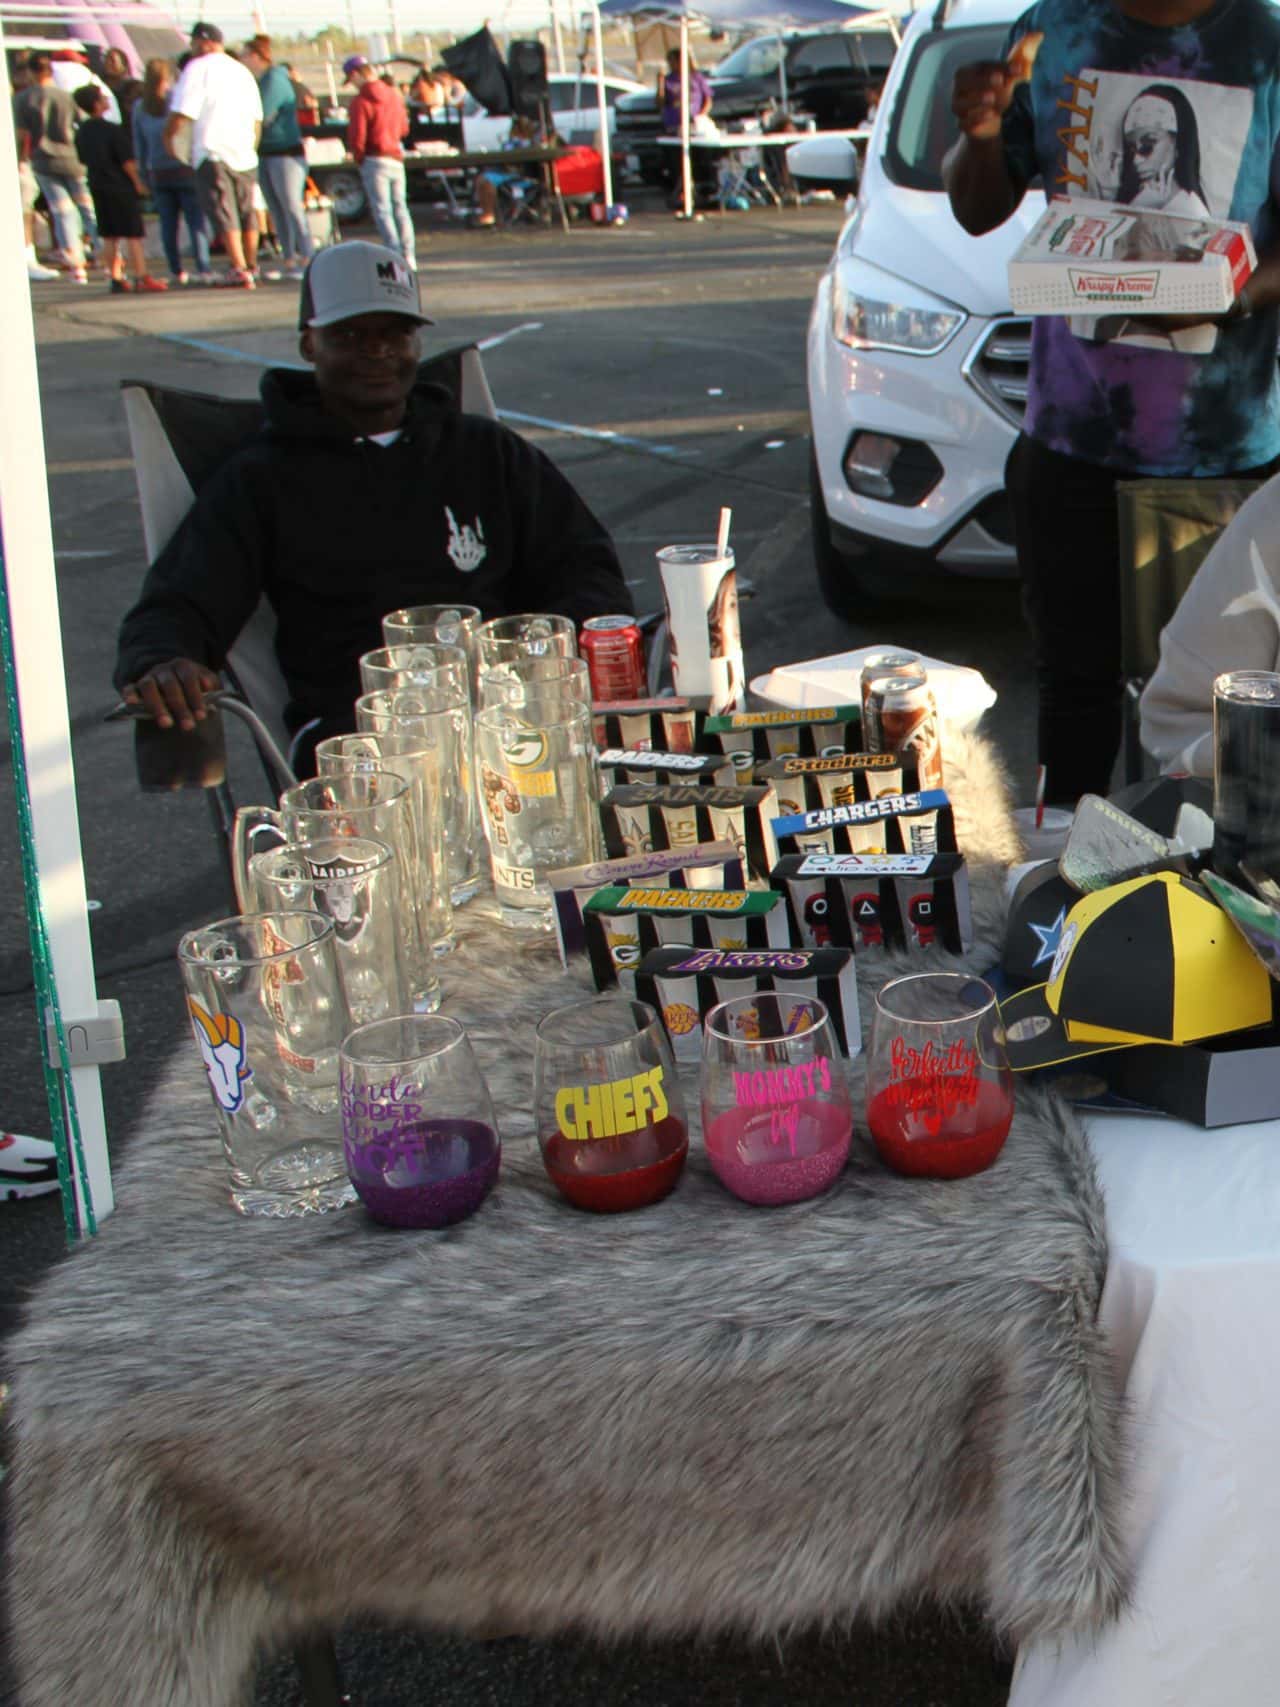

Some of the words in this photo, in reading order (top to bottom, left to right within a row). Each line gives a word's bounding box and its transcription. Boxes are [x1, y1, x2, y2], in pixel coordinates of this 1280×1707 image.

[598, 749, 709, 770] RAIDERS
[632, 787, 744, 801] SAINTS
[805, 793, 921, 829] CHARGERS
[616, 888, 750, 911] PACKERS
[667, 948, 814, 971] LAKERS
[732, 1055, 831, 1105] MOMMY'S
[555, 1065, 669, 1140] CHIEFS
